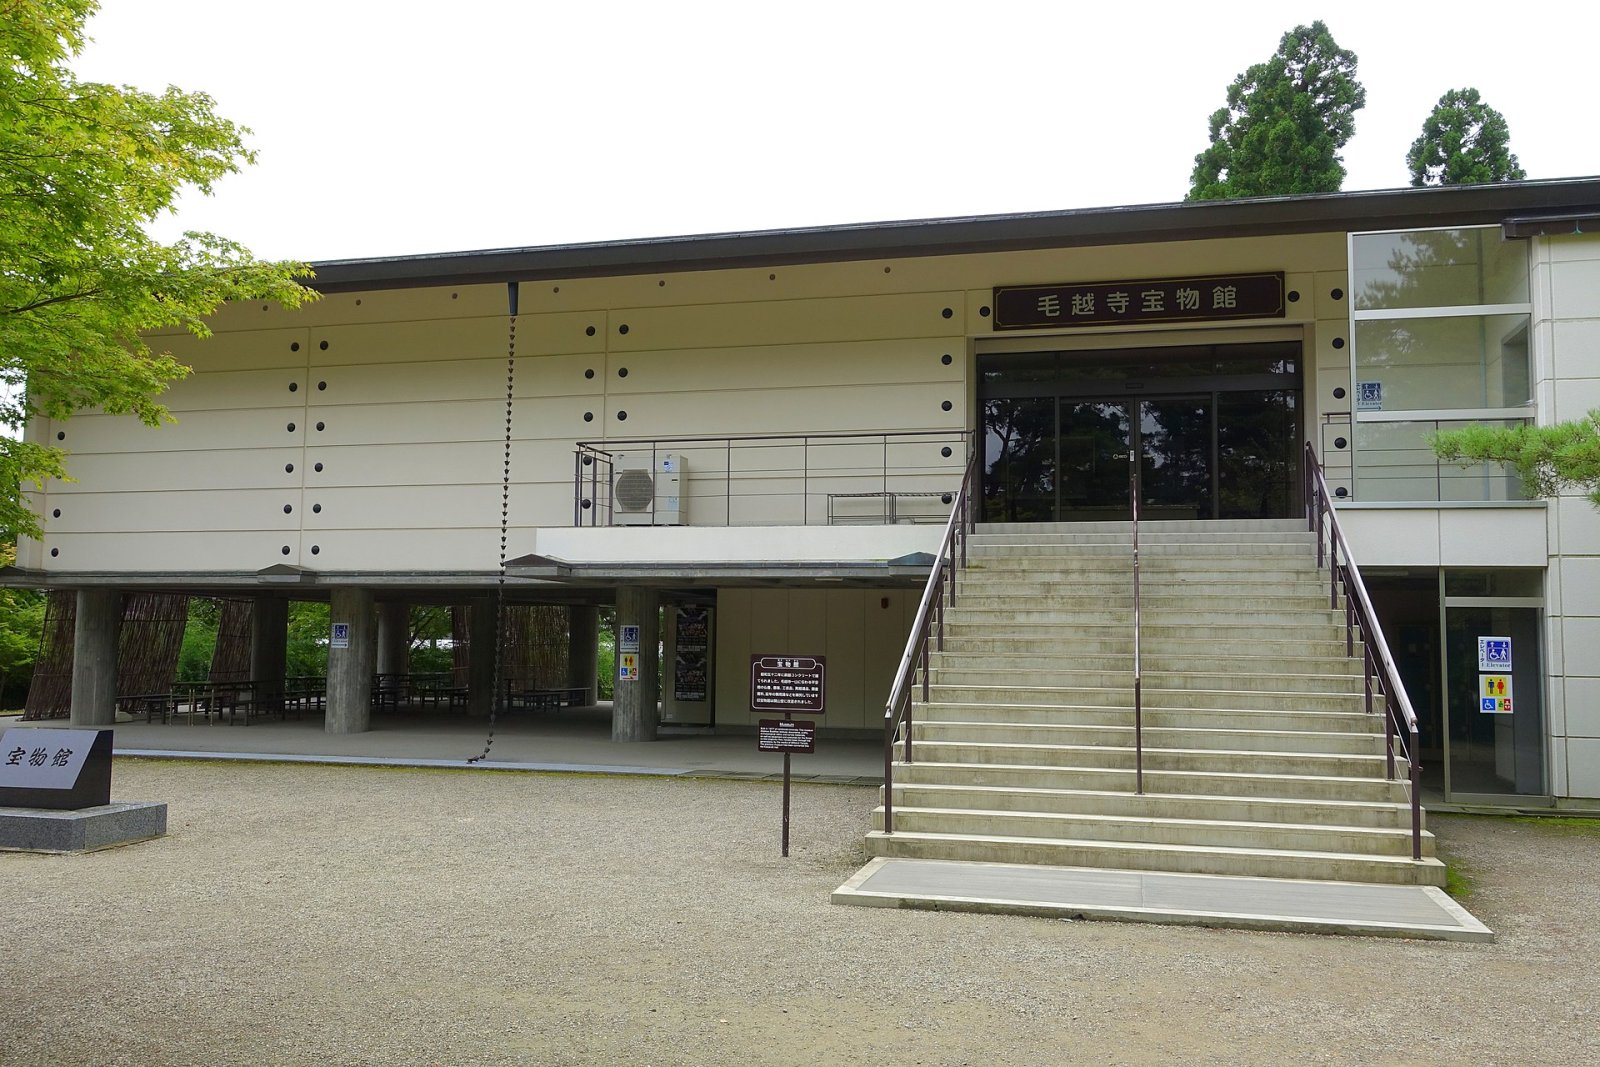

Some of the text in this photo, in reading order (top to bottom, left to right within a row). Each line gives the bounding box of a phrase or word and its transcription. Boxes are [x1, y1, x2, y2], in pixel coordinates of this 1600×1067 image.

[1037, 285, 1237, 317] 毛越寺宝物館
[5, 746, 73, 767] 宝物館
